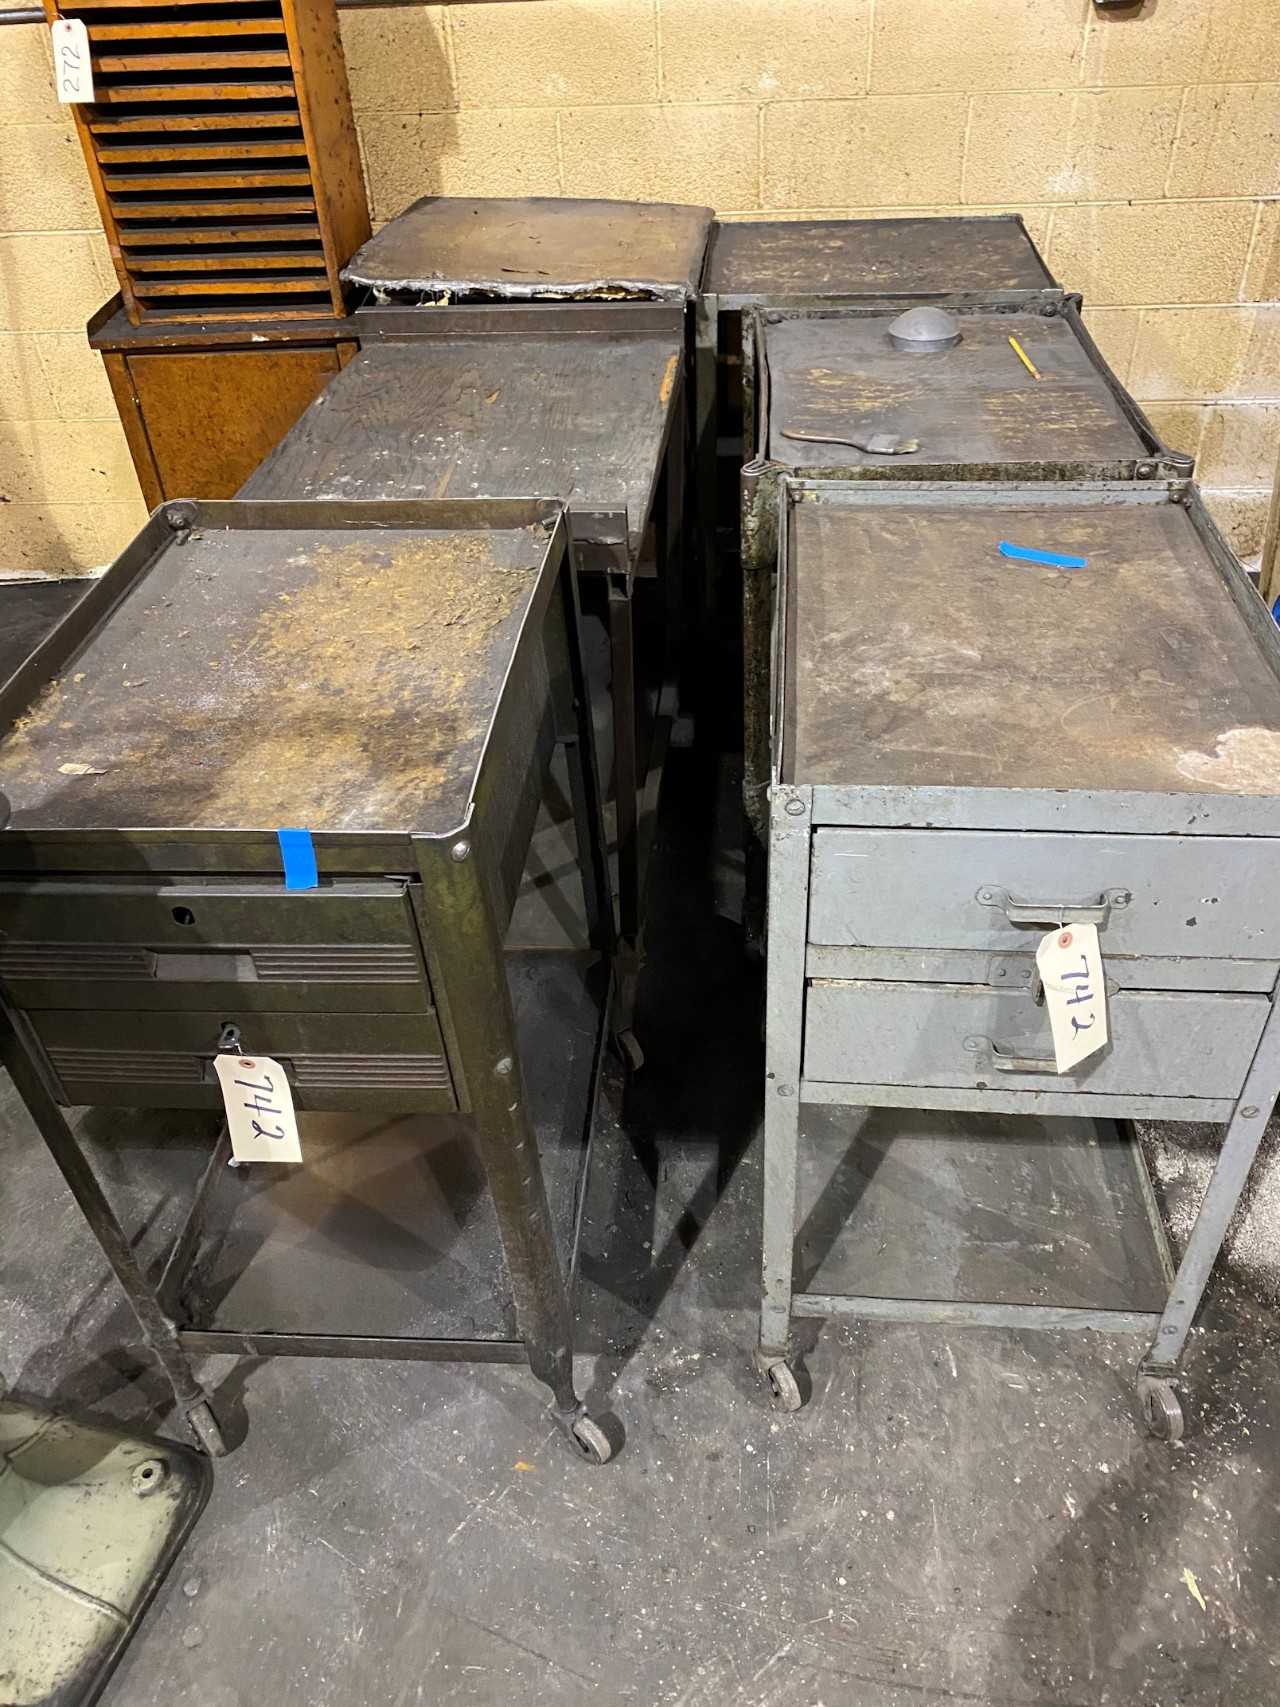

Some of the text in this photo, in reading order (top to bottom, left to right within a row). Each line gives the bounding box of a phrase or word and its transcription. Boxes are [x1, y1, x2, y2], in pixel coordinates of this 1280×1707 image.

[62, 45, 81, 93] 272
[1060, 953, 1095, 1040] 742
[234, 1074, 285, 1141] 742
